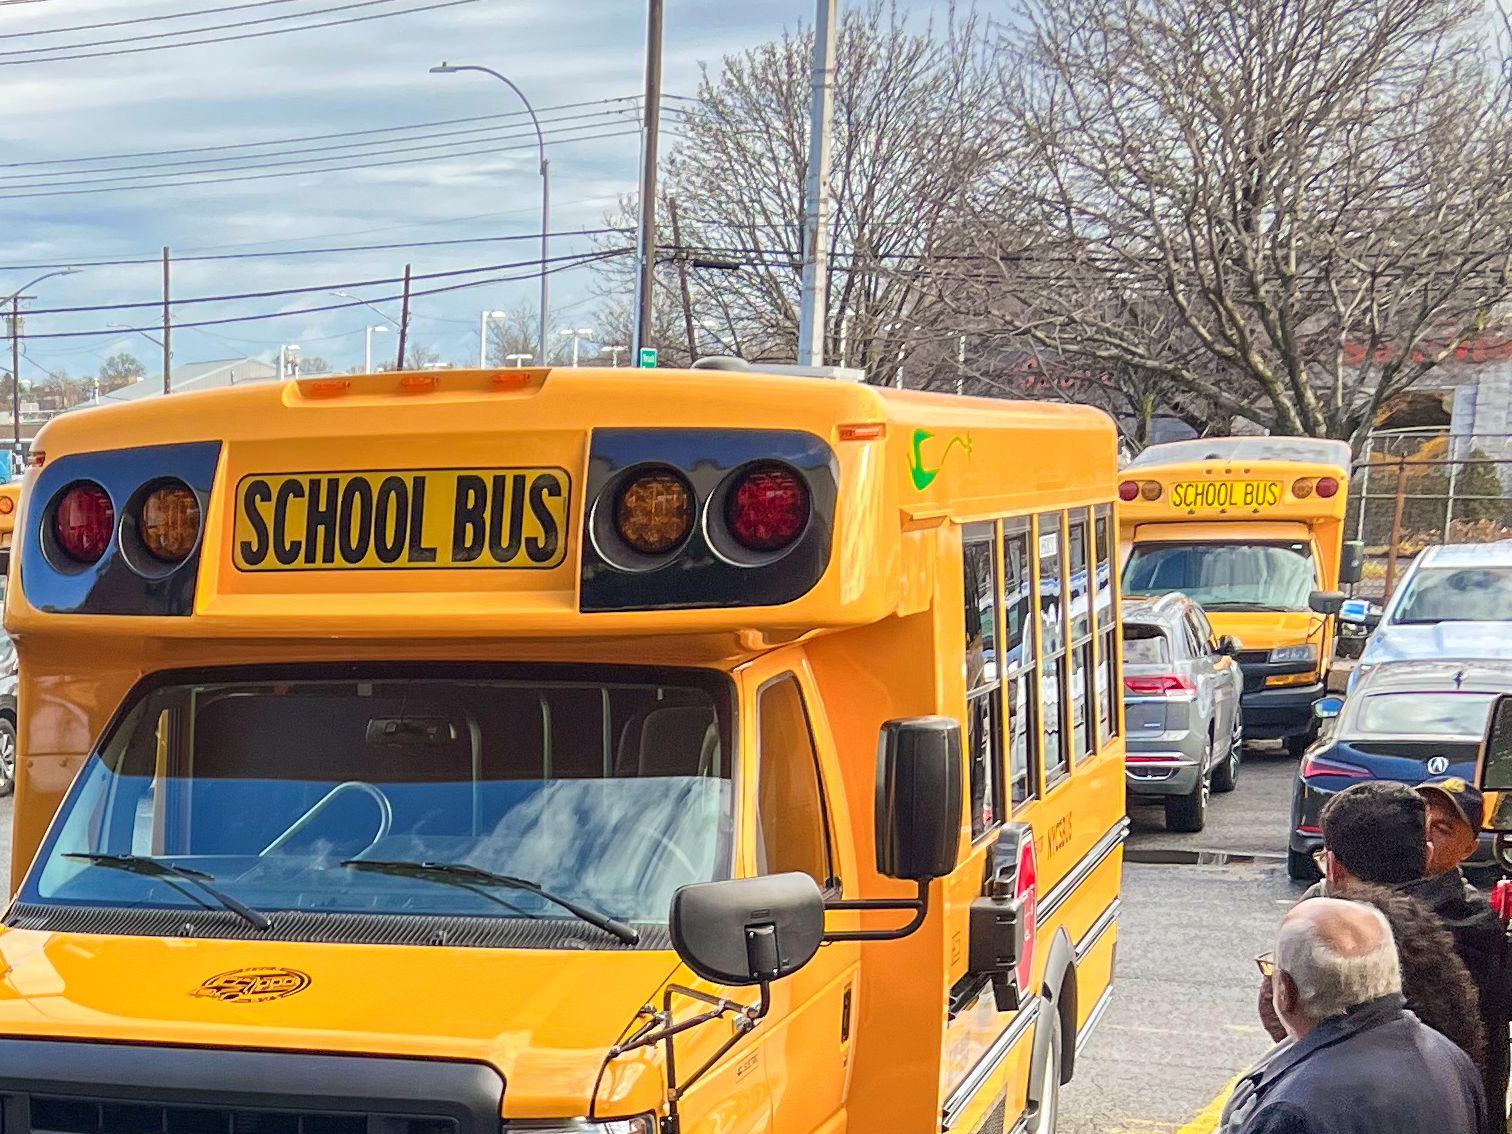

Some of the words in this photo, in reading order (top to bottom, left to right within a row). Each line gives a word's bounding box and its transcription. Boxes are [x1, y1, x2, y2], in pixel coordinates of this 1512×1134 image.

[240, 476, 438, 566] SCHOOL
[451, 474, 563, 563] BUS
[1173, 482, 1237, 507] SCHOOL
[1244, 482, 1278, 506] BUS
